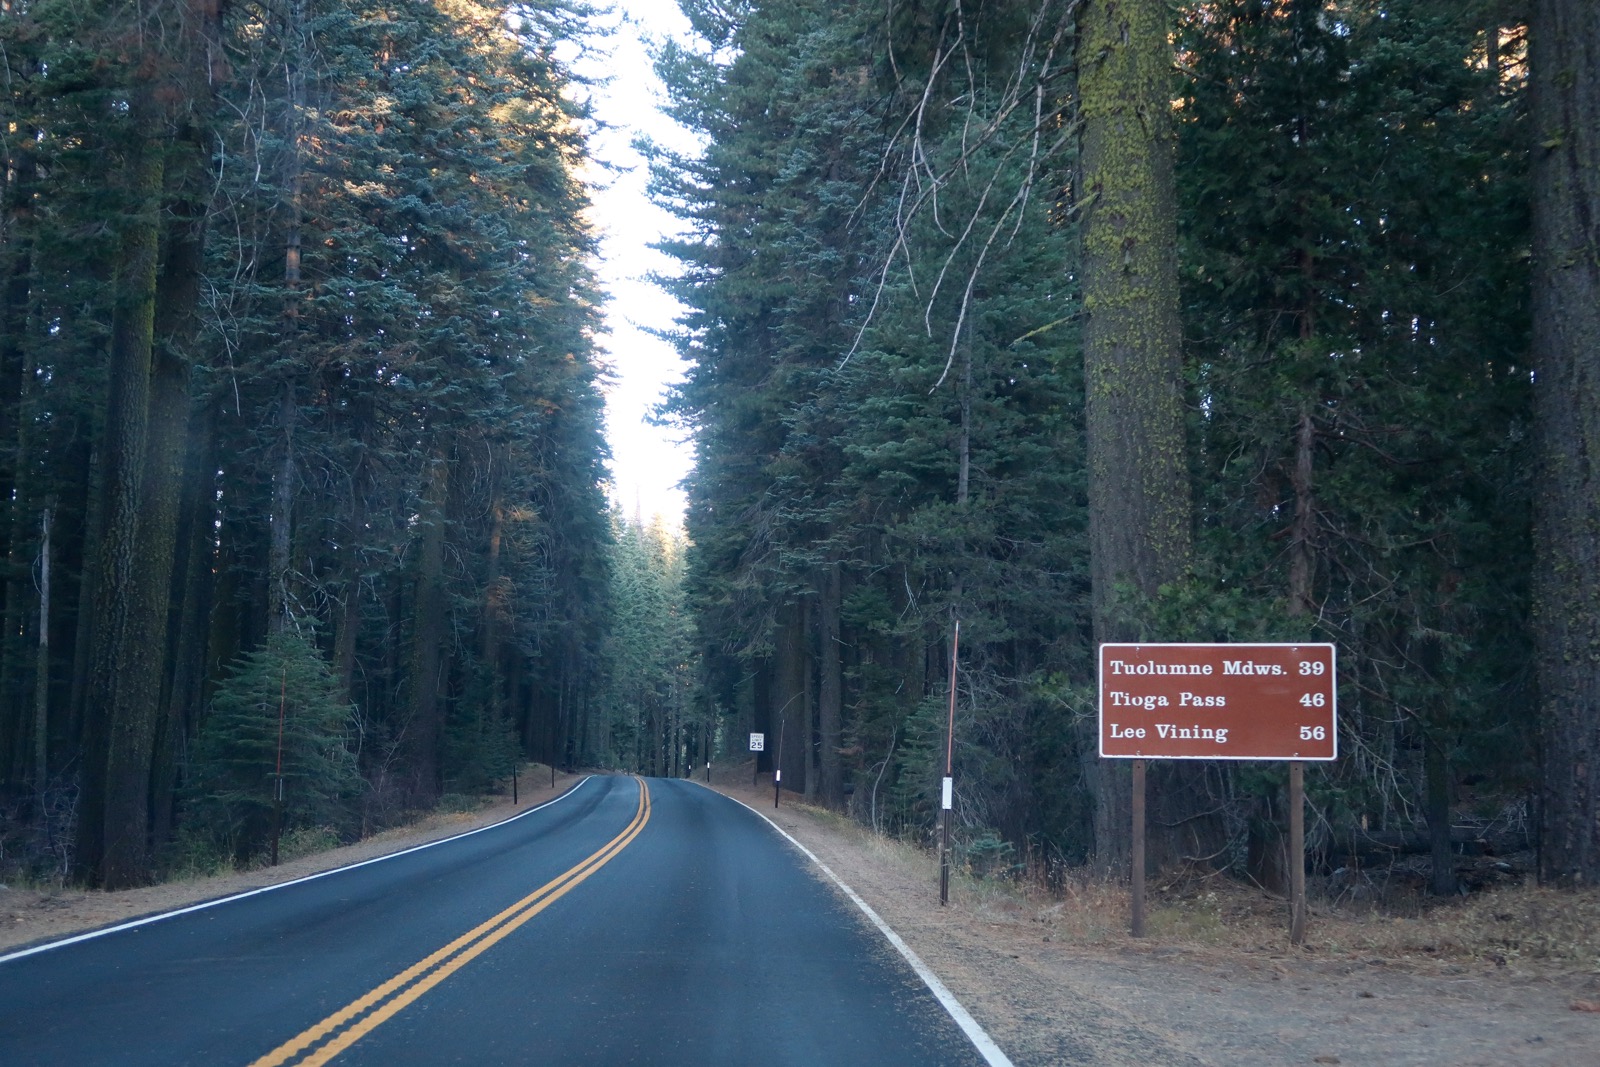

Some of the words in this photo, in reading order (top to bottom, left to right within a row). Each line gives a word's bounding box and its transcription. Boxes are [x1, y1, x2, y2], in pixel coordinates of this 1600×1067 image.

[1110, 660, 1213, 676] Tuolumne
[1223, 660, 1288, 676] Mdws.
[1298, 661, 1325, 676] 39
[1110, 691, 1170, 710] Tioga
[1179, 692, 1226, 707] Pass
[1299, 693, 1326, 708] 46
[1110, 723, 1147, 739] Lee
[1155, 723, 1229, 743] Vining
[1299, 726, 1326, 741] 56
